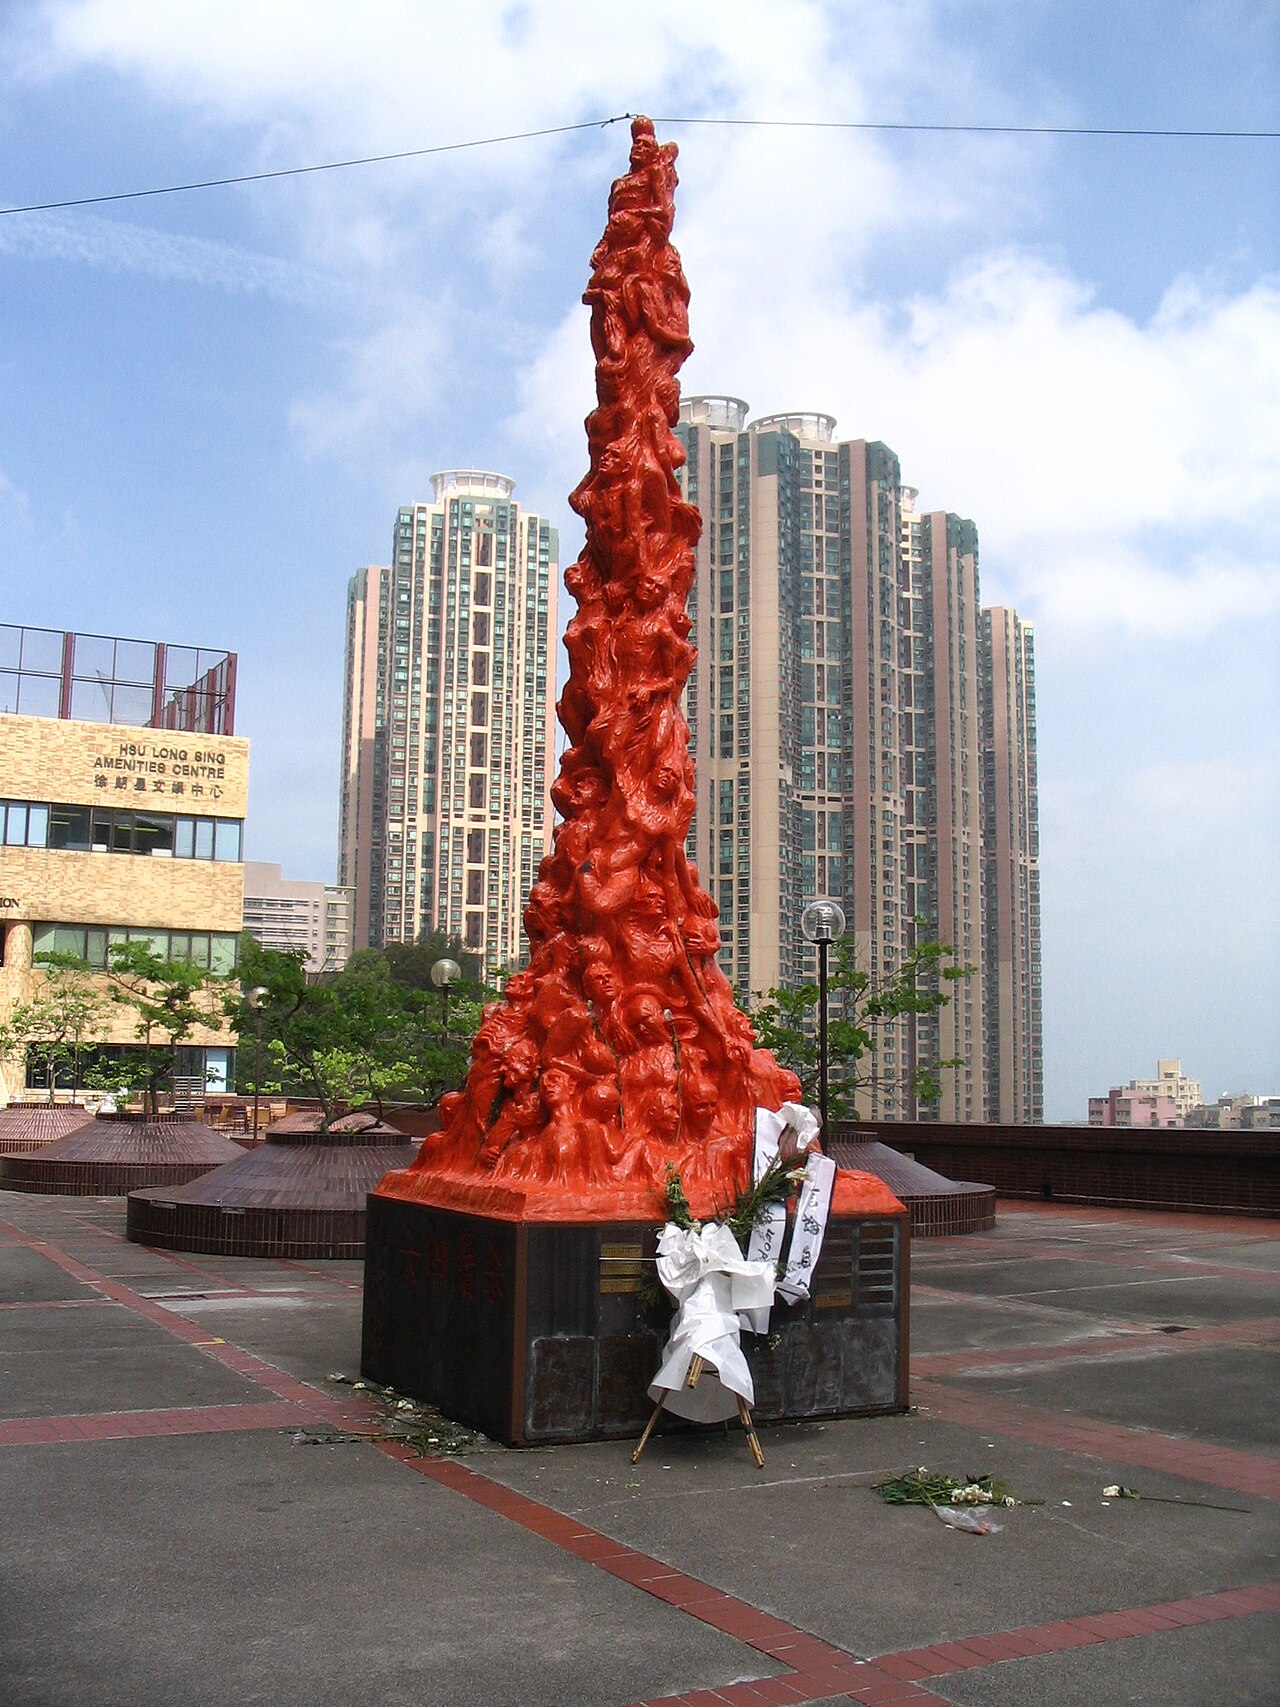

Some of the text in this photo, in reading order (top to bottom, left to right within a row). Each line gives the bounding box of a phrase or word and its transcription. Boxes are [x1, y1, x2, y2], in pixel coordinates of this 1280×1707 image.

[120, 743, 225, 765] HSU LONG SING
[93, 757, 225, 779] AMENITIES CENTRE
